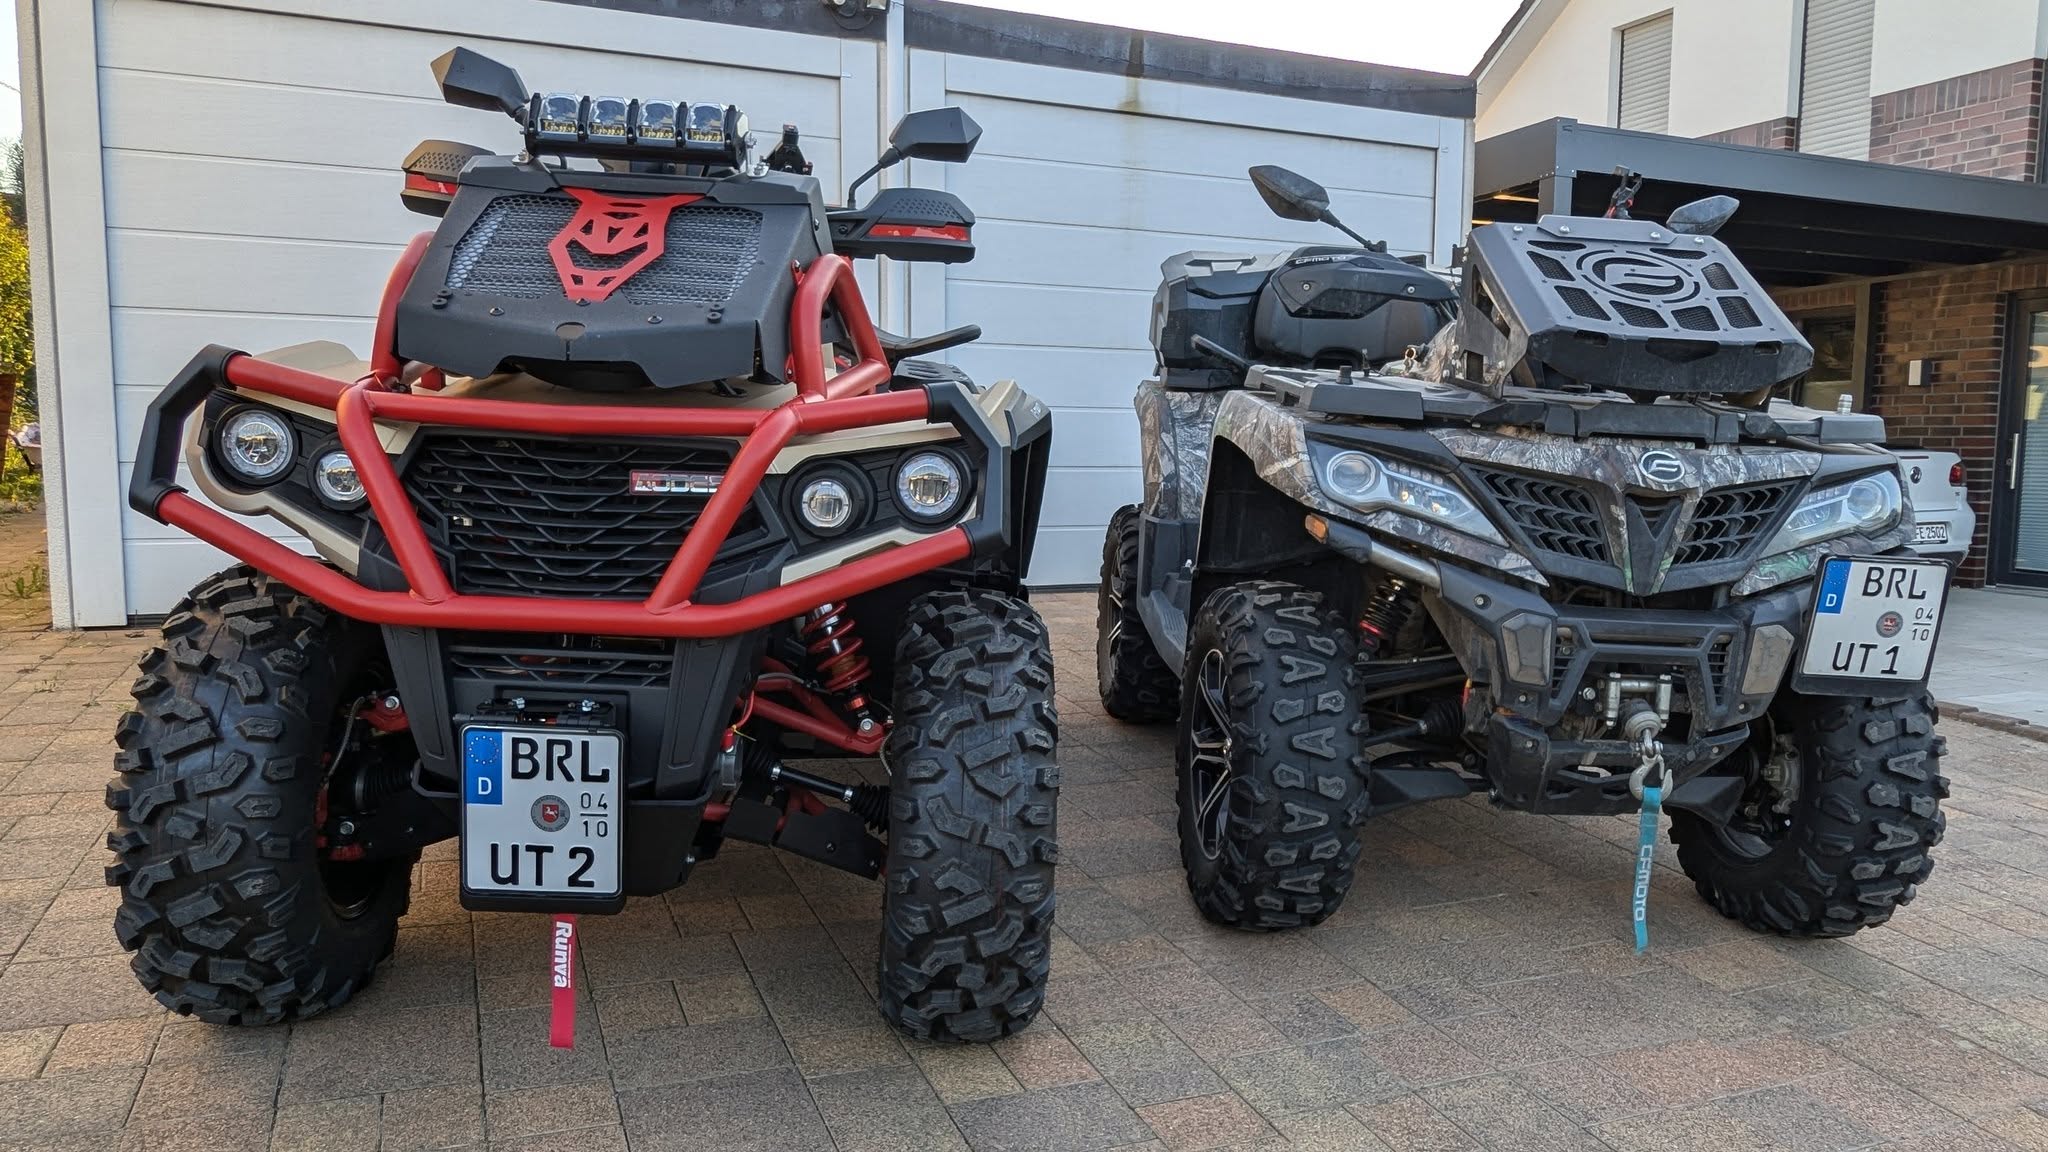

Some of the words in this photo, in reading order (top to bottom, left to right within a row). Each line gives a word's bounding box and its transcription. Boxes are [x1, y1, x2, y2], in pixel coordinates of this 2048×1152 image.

[1862, 566, 1927, 600] BRL
[1825, 593, 1837, 607] D
[1915, 607, 1934, 620] 04
[1911, 628, 1930, 641] 10
[1832, 641, 1878, 673] UT
[1880, 645, 1900, 675] 1
[511, 737, 610, 783] BRL
[477, 776, 492, 795] D
[580, 792, 608, 810] 04
[582, 820, 608, 838] 10
[490, 843, 554, 886] UT
[567, 846, 595, 888] 2
[1635, 844, 1653, 921] CFMOTO
[554, 921, 573, 988] Runva
